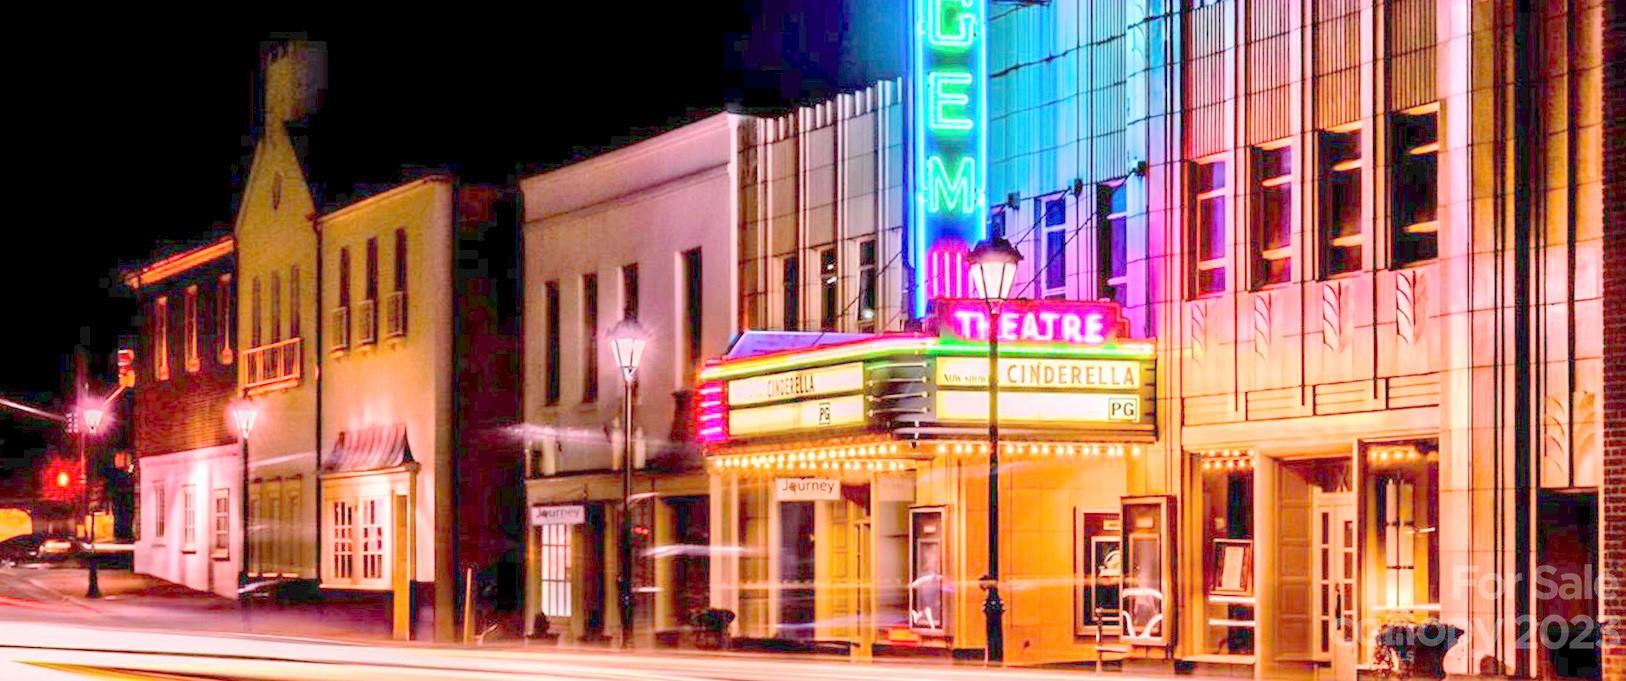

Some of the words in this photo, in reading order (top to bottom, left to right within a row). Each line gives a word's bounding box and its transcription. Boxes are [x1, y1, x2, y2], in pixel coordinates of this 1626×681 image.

[928, 0, 975, 214] GEM
[954, 310, 1105, 344] THEATRE
[1007, 363, 1135, 386] CINDERELLA
[767, 375, 815, 398] CINDERELLA
[819, 407, 830, 421] PG
[1111, 402, 1135, 416] PG
[782, 480, 835, 494] Journey
